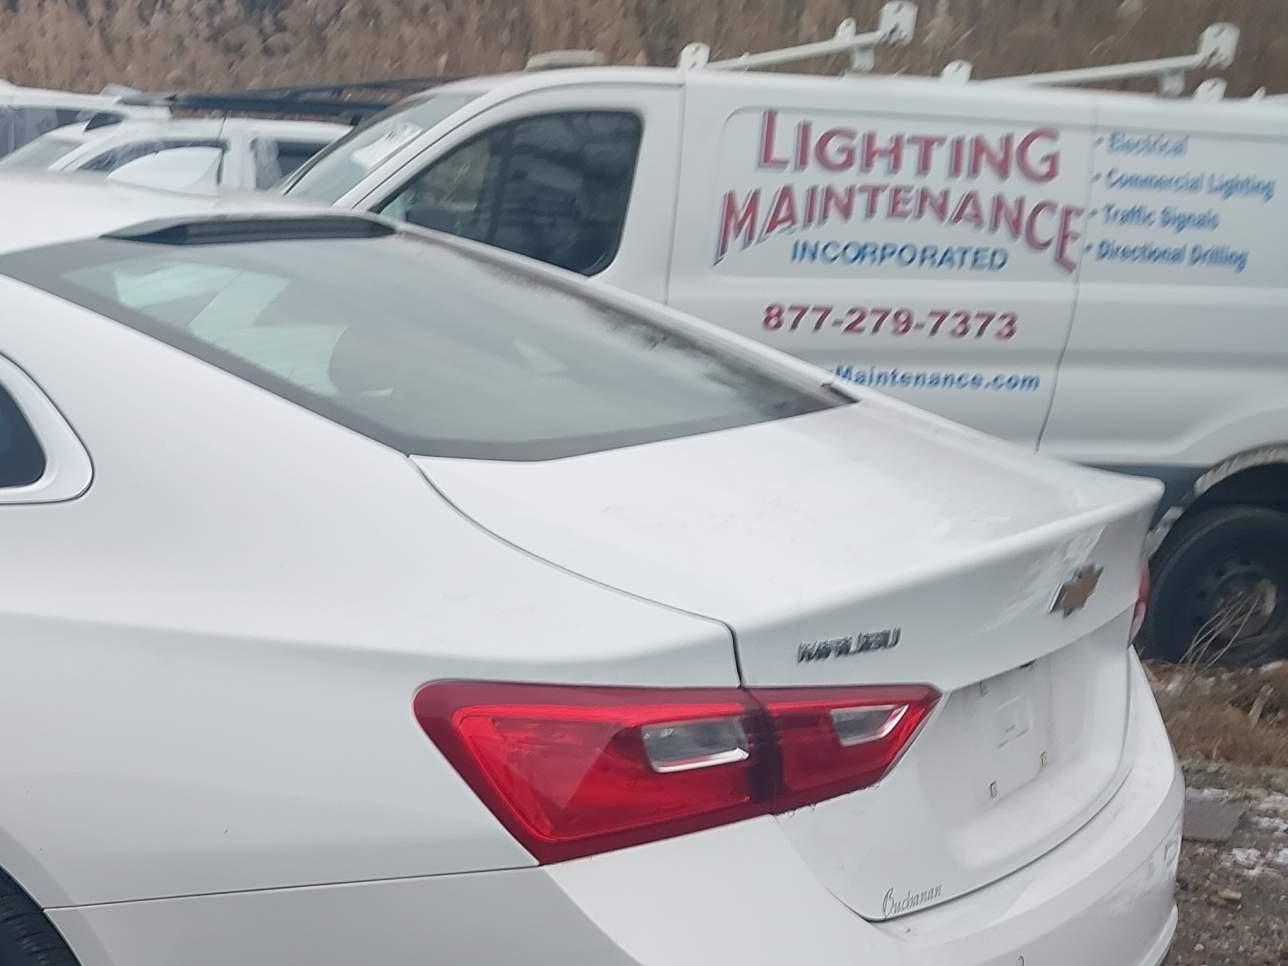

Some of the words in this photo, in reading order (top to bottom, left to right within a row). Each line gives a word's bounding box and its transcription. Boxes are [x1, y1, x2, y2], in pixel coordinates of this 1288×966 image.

[759, 109, 1061, 184] LIGHTING
[1108, 130, 1188, 157] Electrical
[1106, 168, 1204, 192] Commercial
[1207, 173, 1275, 201] Lighting
[712, 184, 1084, 273] MAINTENANCE
[1103, 203, 1155, 227] Traffic
[1160, 206, 1219, 232] Signals
[791, 240, 1010, 271] INCORPORATED
[1096, 240, 1187, 264] Directional
[1189, 245, 1249, 272] Drilling
[762, 303, 1018, 340] 877-279-7373
[831, 366, 1041, 391] Maintenance.com
[883, 885, 942, 918] Buchanan
